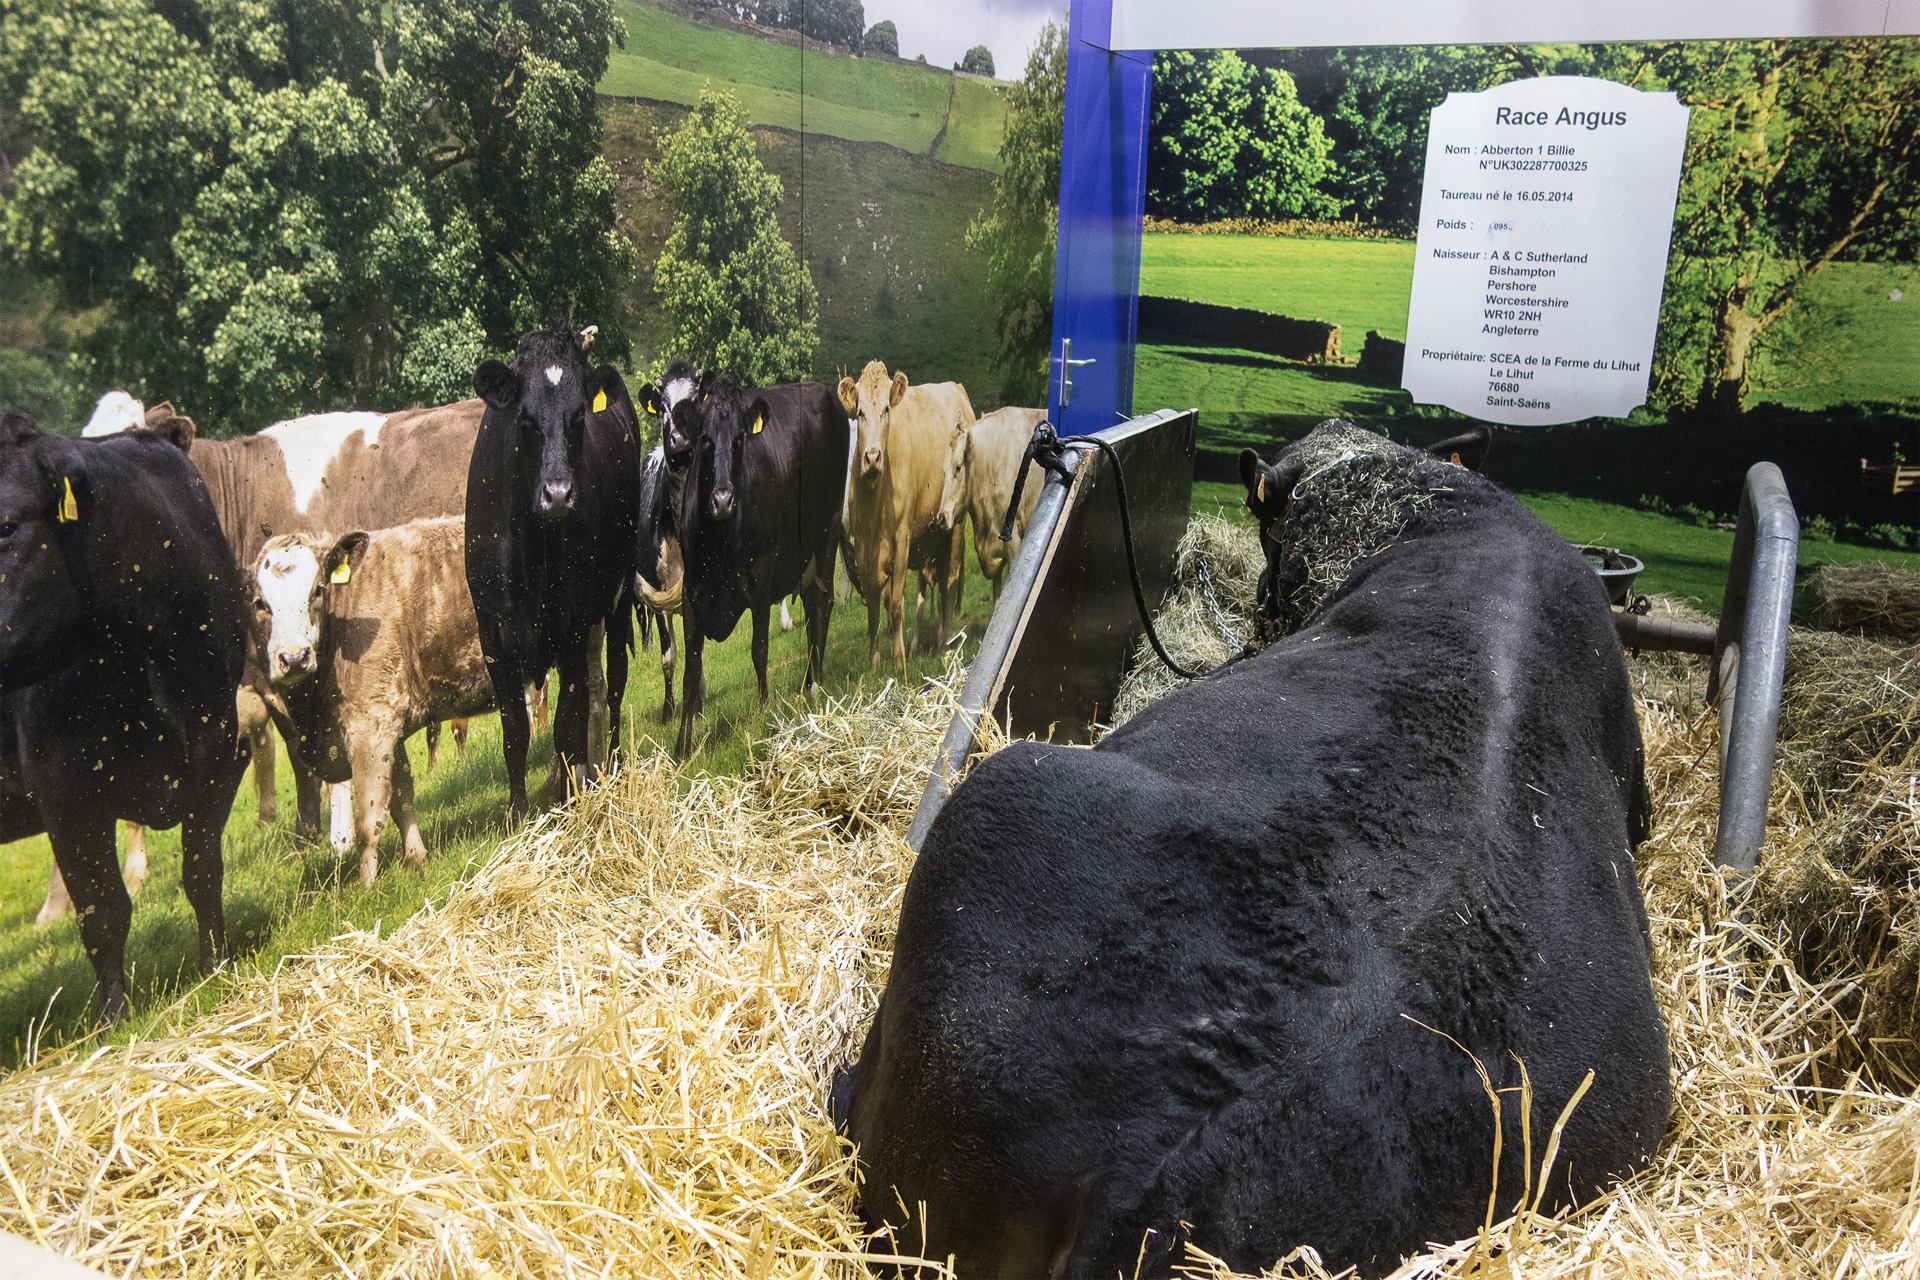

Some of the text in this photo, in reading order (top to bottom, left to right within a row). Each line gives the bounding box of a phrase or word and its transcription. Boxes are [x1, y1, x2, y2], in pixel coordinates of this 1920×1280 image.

[1496, 107, 1626, 130] Race Angus
[1445, 144, 1470, 154] Nom
[1481, 145, 1533, 155] Abberton
[1538, 145, 1542, 155] 1
[1547, 145, 1575, 156] Billie
[1440, 189, 1573, 202] Taureau né le 16.05.2014
[1437, 219, 1466, 229] Poids
[1433, 249, 1480, 259] Naisseur
[1490, 250, 1499, 260] A
[1503, 251, 1510, 260] &
[1515, 251, 1523, 261] C
[1526, 251, 1588, 263] Sutherland
[1490, 265, 1555, 279] Bishampton
[1488, 280, 1536, 292] Pershore
[1486, 295, 1569, 308] Worcestershire
[1484, 309, 1541, 321] WR10 2NH
[1482, 324, 1539, 336] Angleterre
[1422, 349, 1640, 372] Propriétaire: SCEA de la Ferme du Lihut
[1490, 368, 1534, 380] Le Lihut
[1488, 382, 1519, 393] 76680
[1487, 396, 1550, 409] Saint-Saëns
